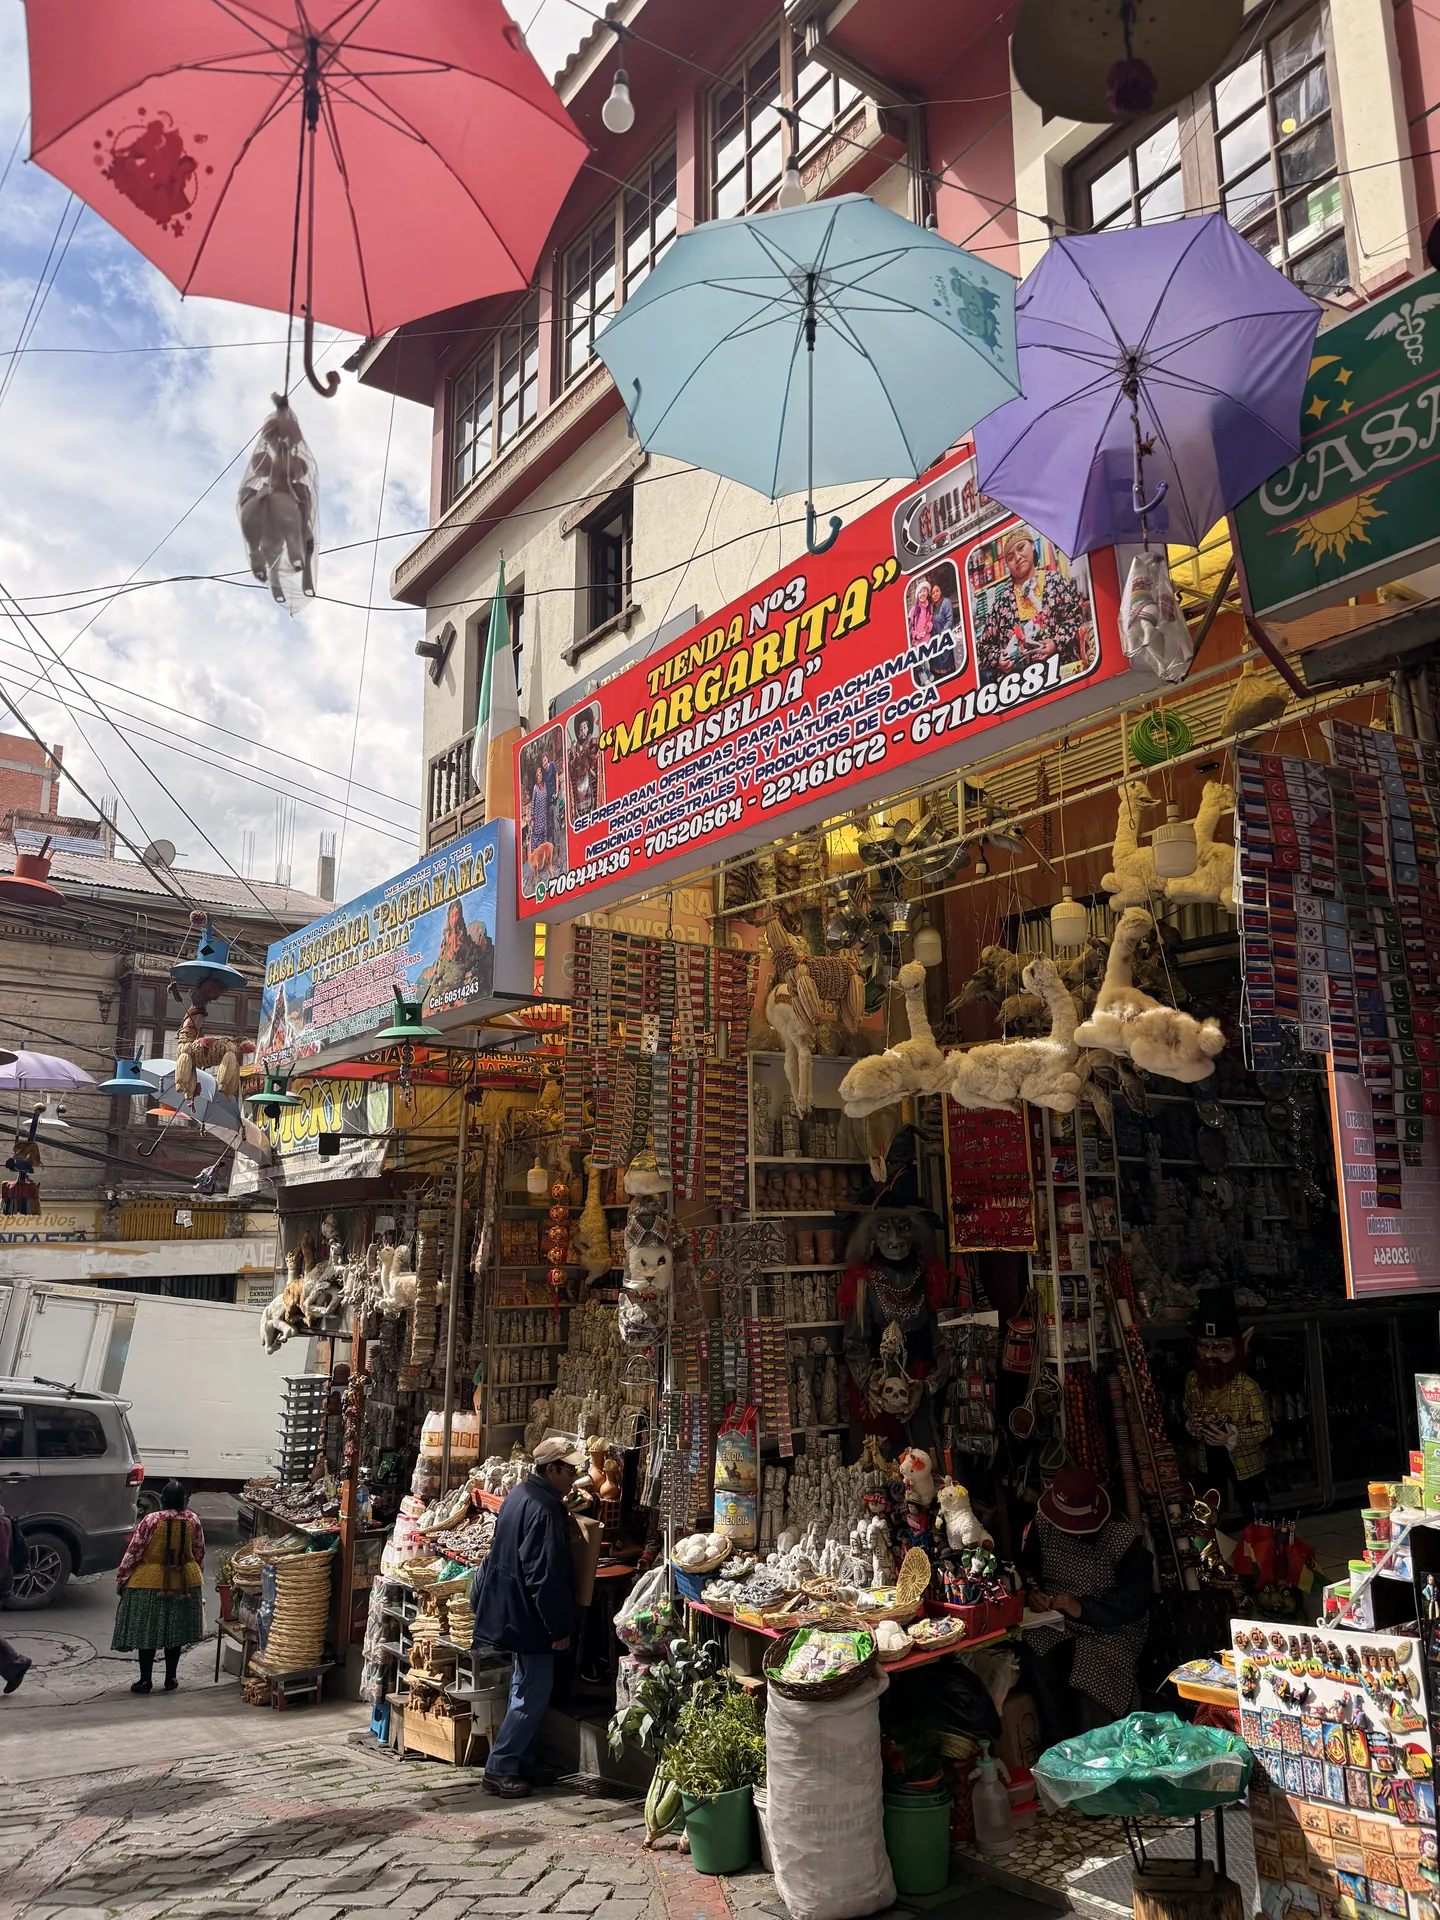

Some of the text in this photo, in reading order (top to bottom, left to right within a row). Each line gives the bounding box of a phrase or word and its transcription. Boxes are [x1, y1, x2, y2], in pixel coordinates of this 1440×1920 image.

[599, 556, 900, 763] “MARGARITA”
[647, 614, 744, 697] TIENDA
[574, 631, 955, 833] SE PREPARAN OFRENDAS PARA LA PACHAMAMA
[609, 685, 892, 832] PRODUCTOS MISTICOS Y NATURALES
[547, 847, 631, 898] 70644436
[645, 797, 743, 857] 70520564
[761, 735, 888, 809] 22461672
[912, 653, 1061, 743] 67116681
[585, 688, 940, 861] MEDICINAS ANCESTRALES Y PRODUCTOS DE COCA
[384, 843, 472, 899] WELCOME TO THE
[266, 846, 494, 989] CASA ESOTERICA “PACHAMAMA”
[282, 912, 347, 954] BIENVENIDOS A LA
[311, 967, 325, 985] DE
[355, 962, 373, 979] MESAS
[373, 946, 409, 970] ESPECIALES
[429, 982, 479, 1009] Cel: 60514243
[717, 1515, 749, 1526] BUEN DIA
